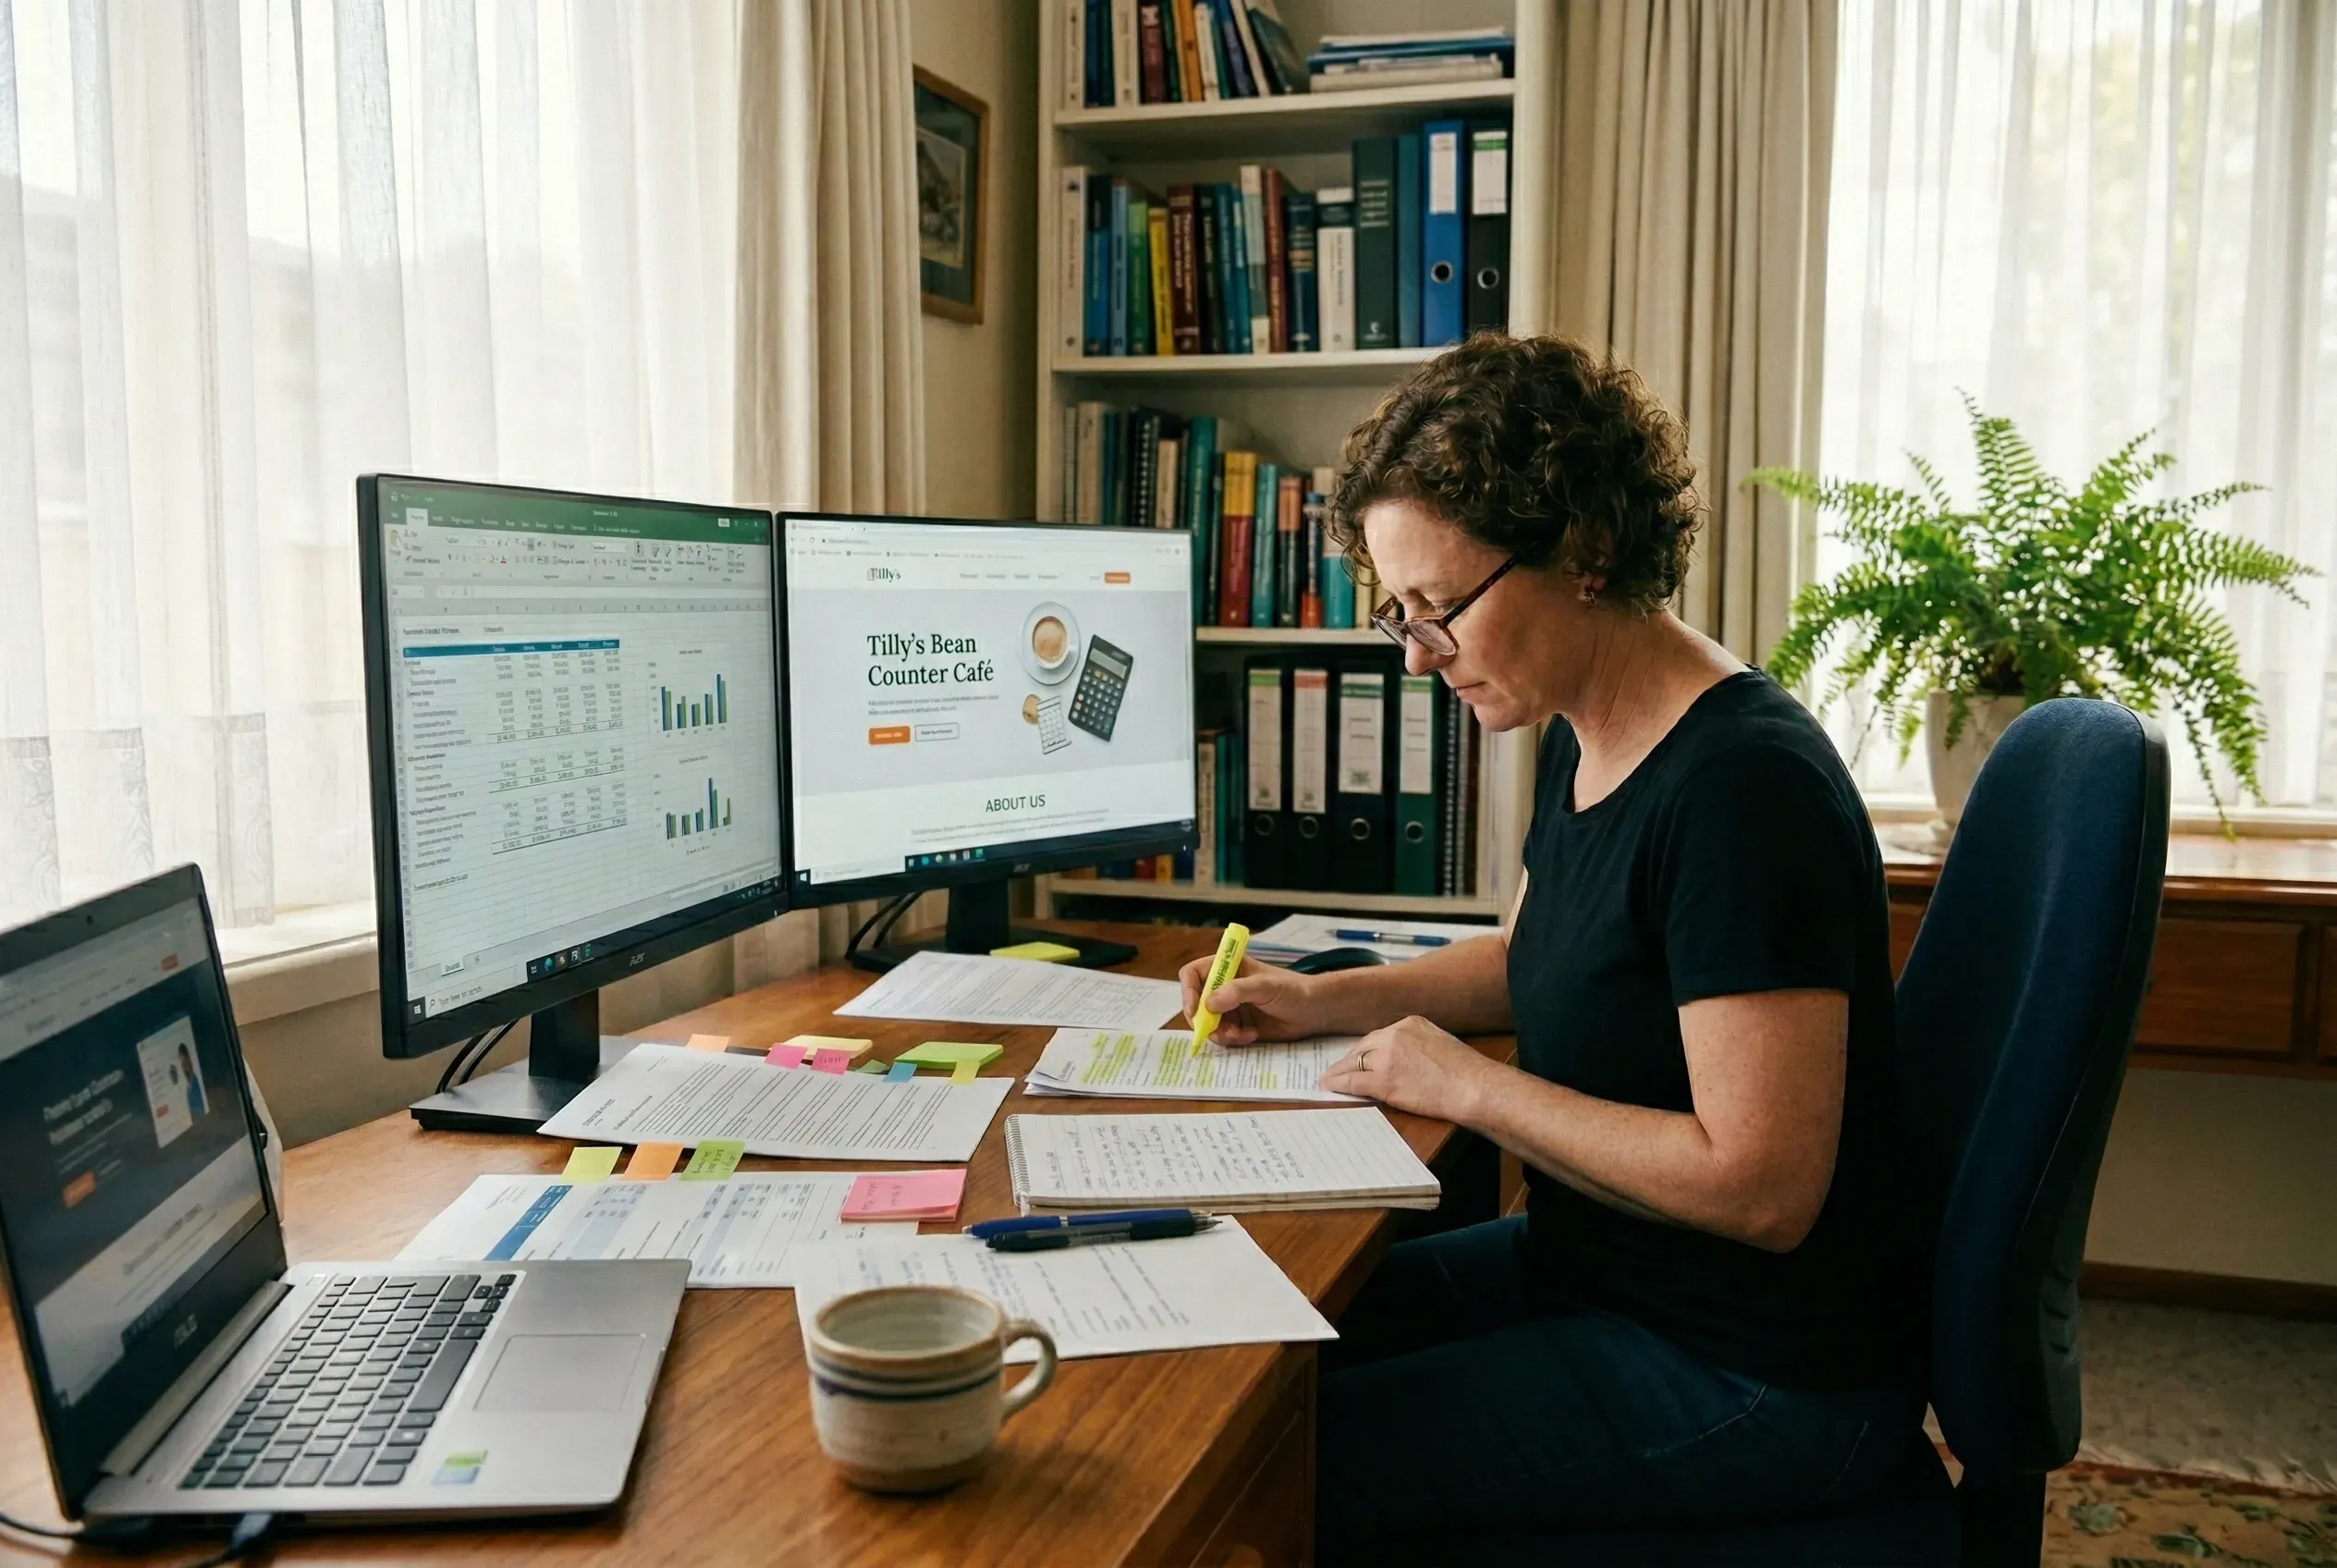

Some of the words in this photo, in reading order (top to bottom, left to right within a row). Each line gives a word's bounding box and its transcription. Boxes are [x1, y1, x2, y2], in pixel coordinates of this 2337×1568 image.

[867, 632, 925, 662] Tilly's
[930, 633, 977, 654] Bean
[868, 665, 948, 687] Counter
[953, 659, 994, 682] Café
[985, 796, 1026, 813] ABOUT
[1030, 794, 1046, 808] US
